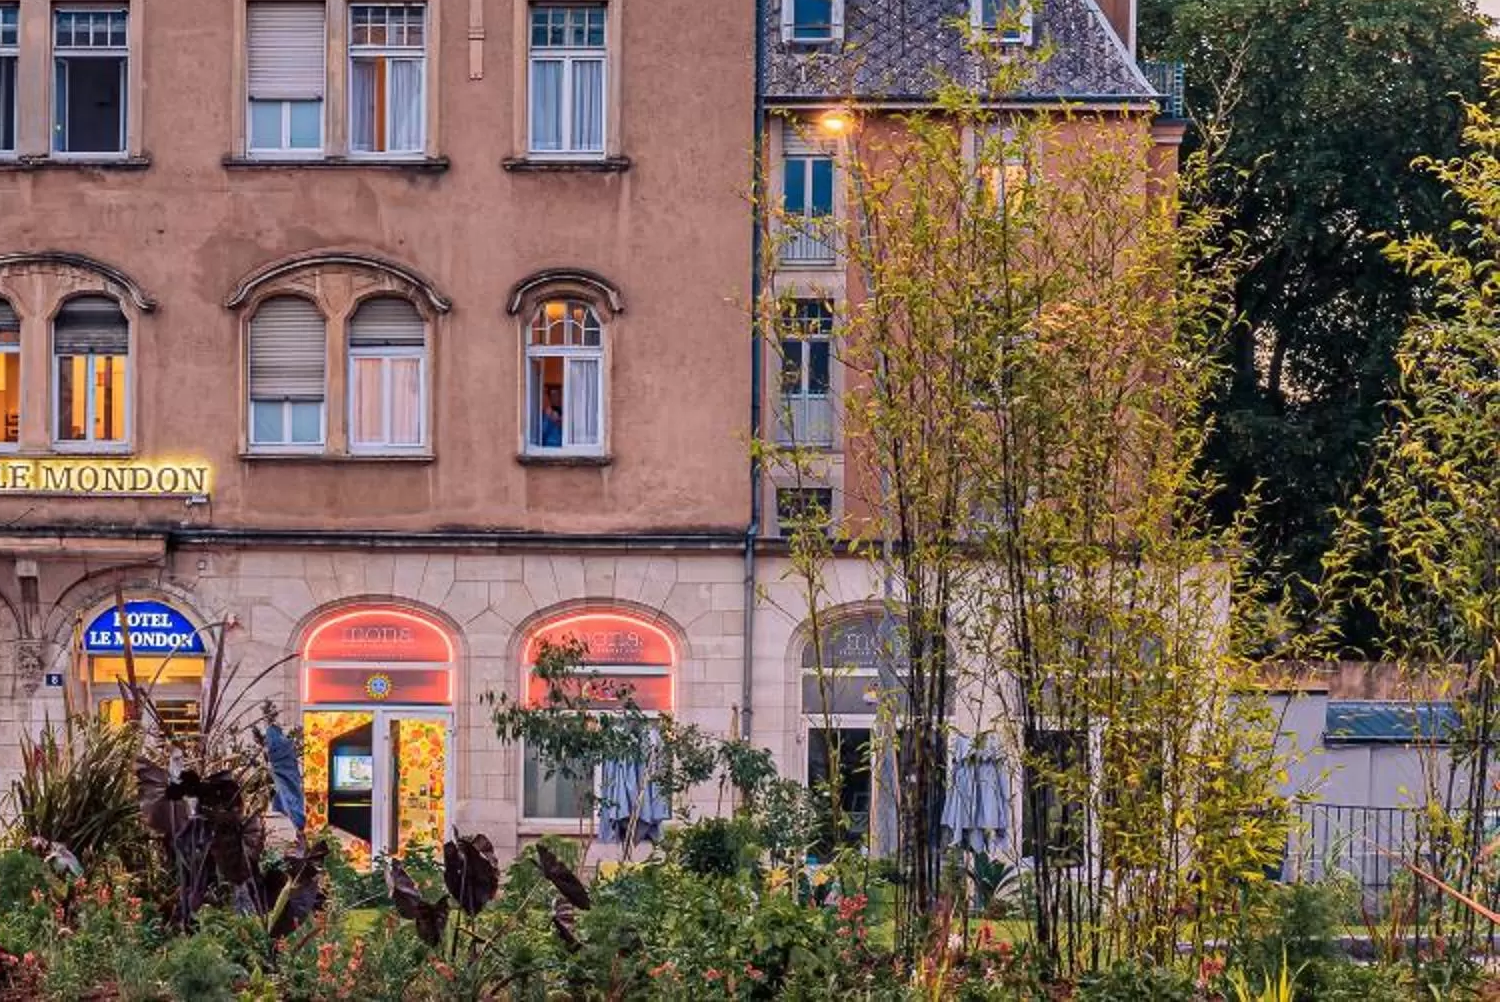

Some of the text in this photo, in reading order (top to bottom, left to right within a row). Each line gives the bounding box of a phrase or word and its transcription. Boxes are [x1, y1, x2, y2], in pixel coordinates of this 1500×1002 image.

[42, 466, 208, 493] MONDON
[90, 631, 194, 647] LE MONDON
